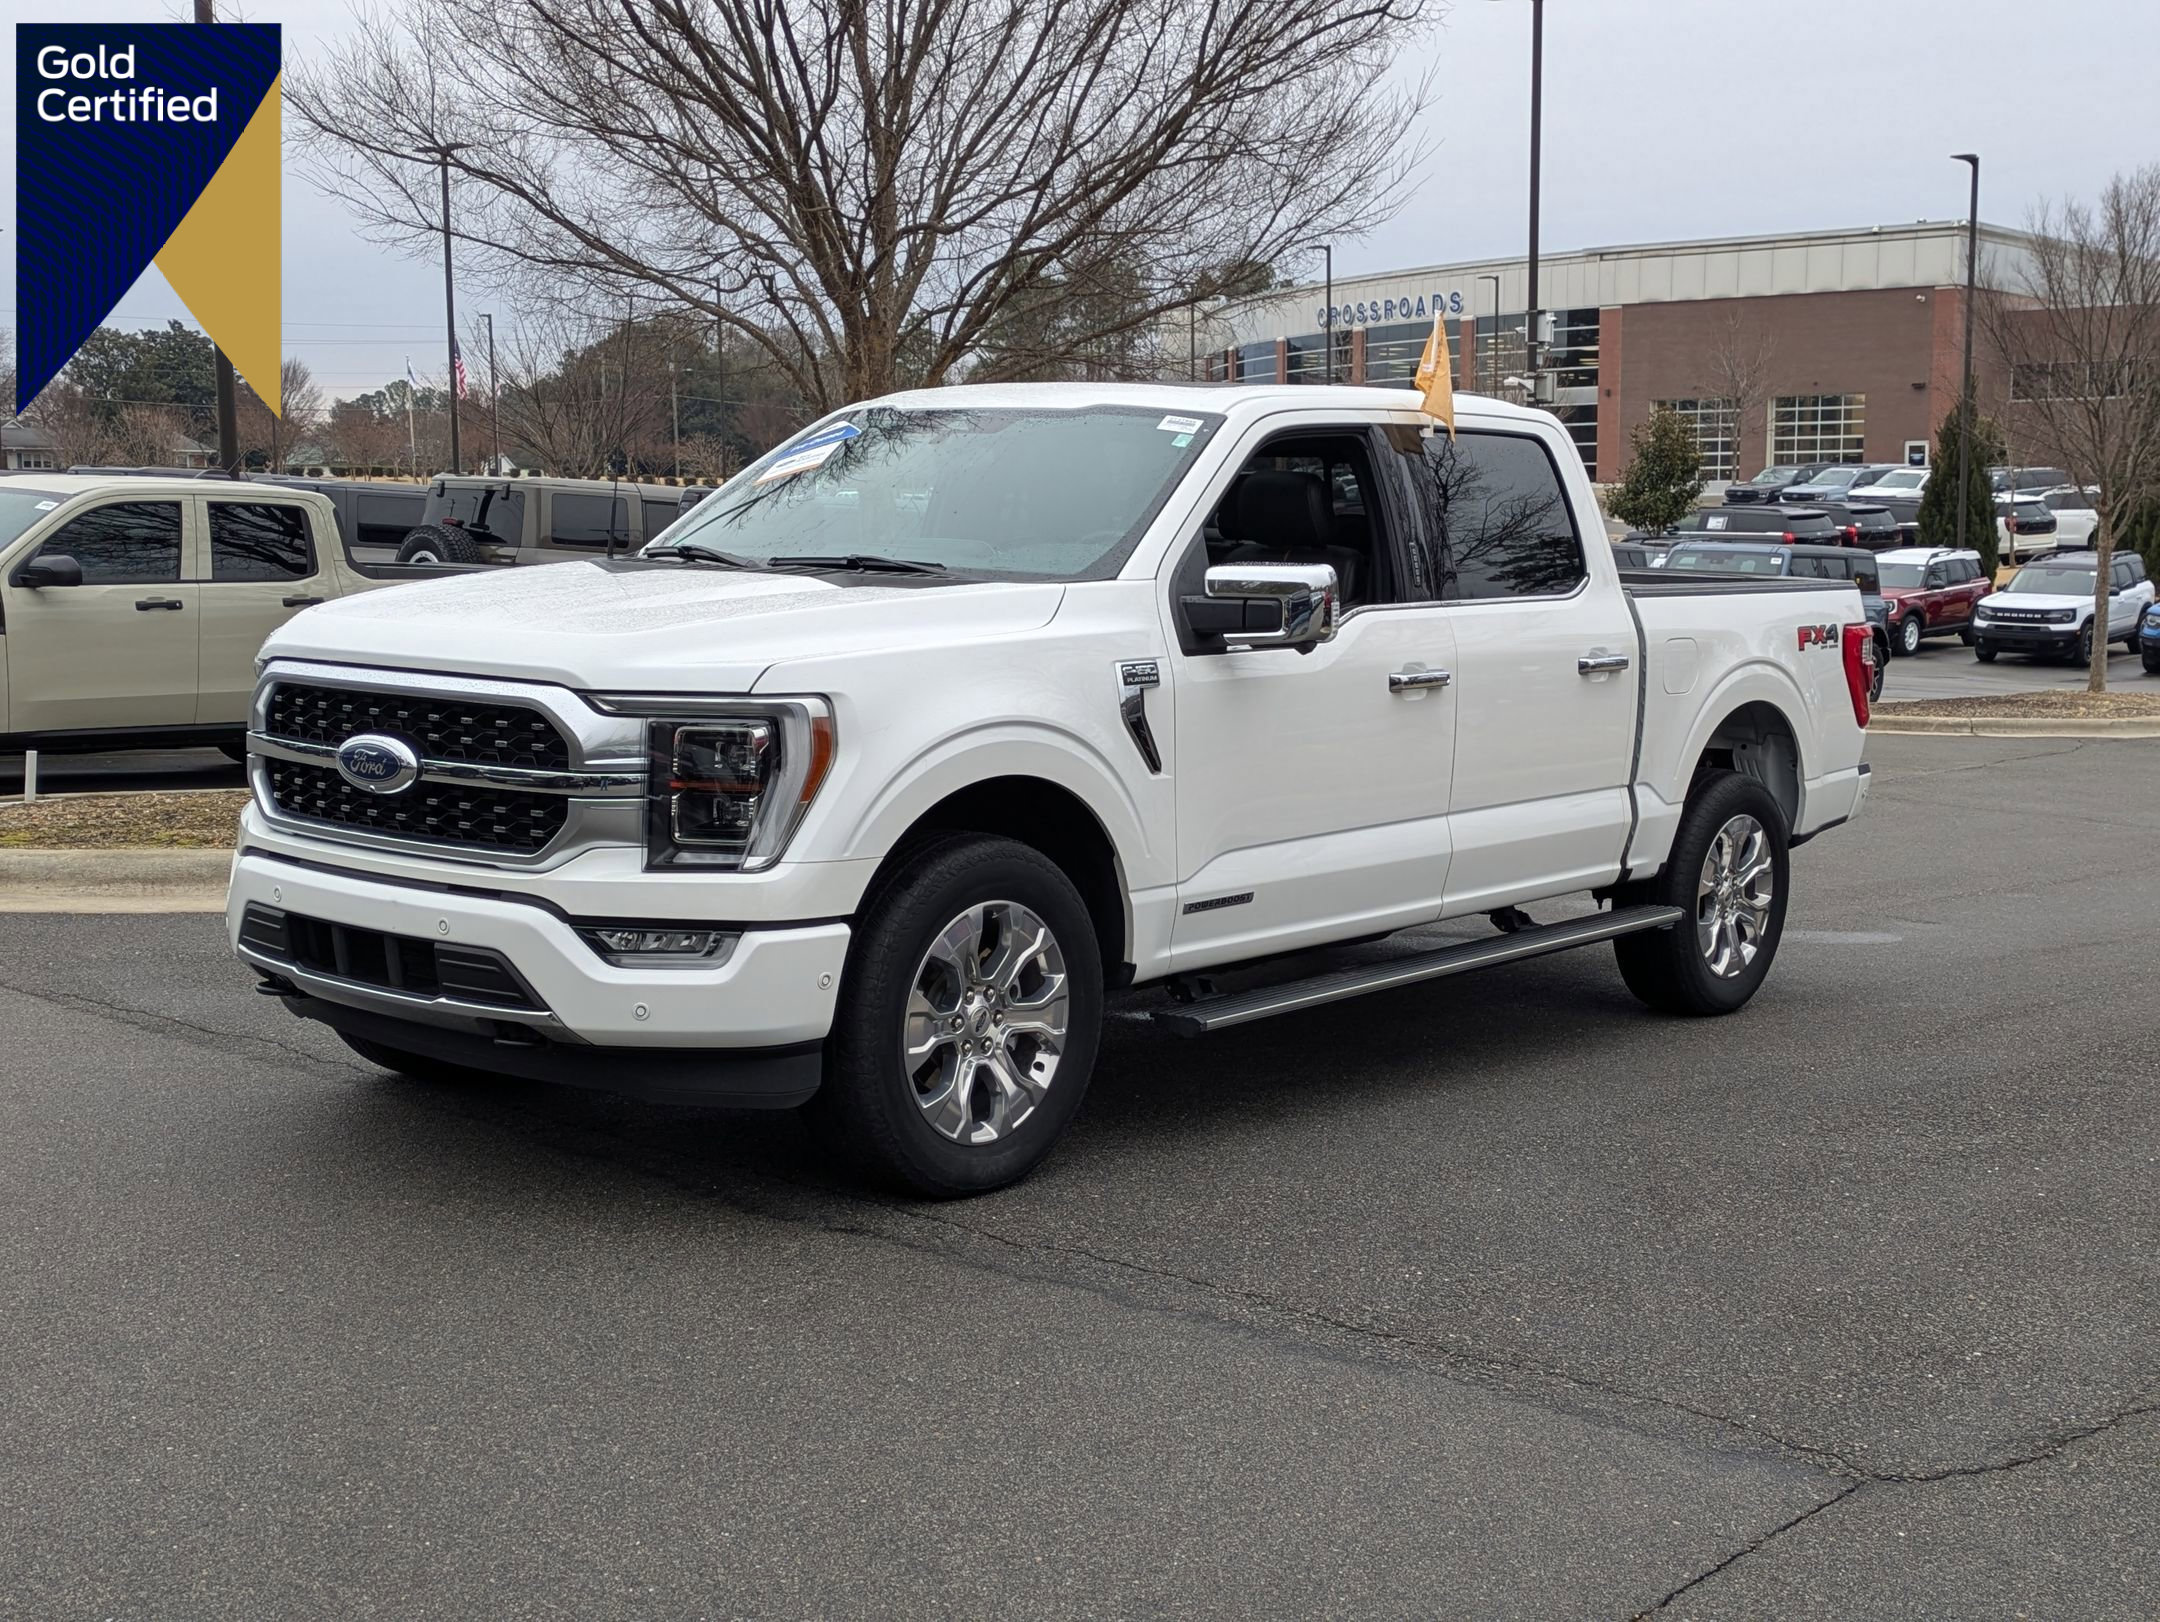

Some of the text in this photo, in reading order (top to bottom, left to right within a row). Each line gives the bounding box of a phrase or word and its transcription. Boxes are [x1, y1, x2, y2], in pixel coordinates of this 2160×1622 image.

[1318, 291, 1463, 328] CROSSROADS
[1797, 623, 1839, 651] FX4
[350, 748, 387, 775] Ford
